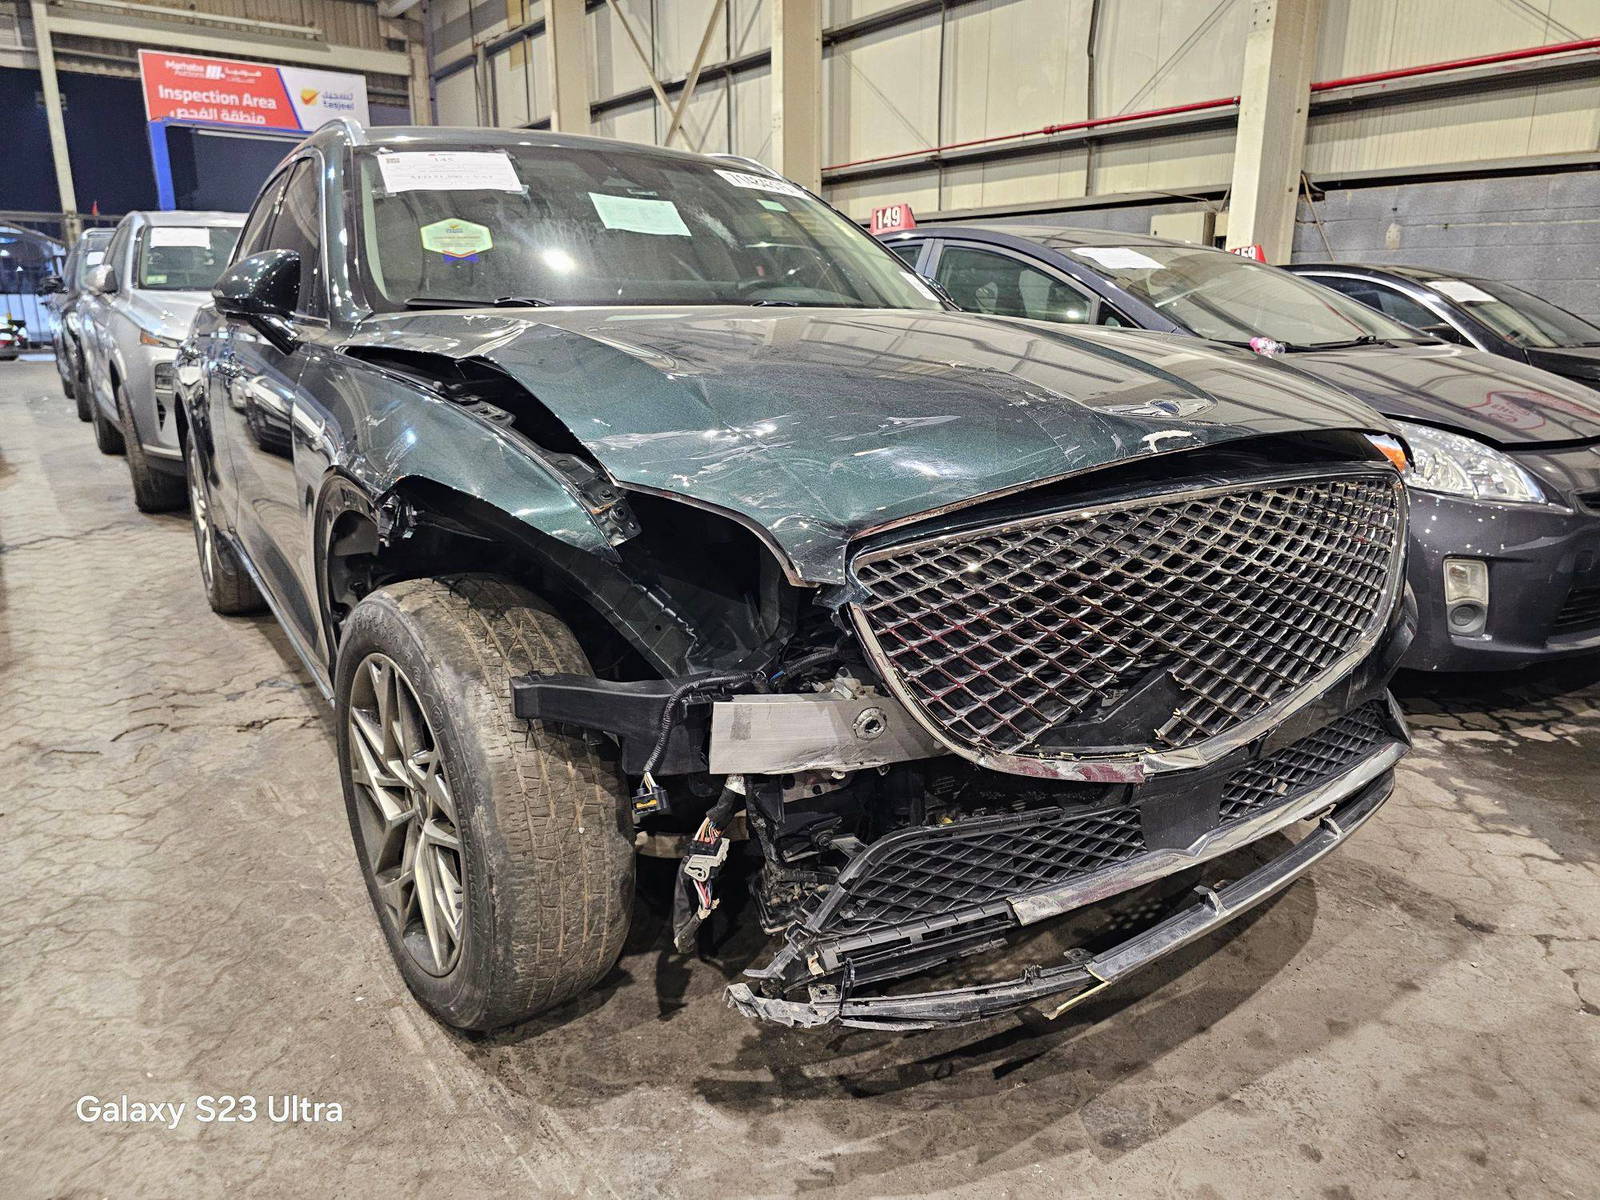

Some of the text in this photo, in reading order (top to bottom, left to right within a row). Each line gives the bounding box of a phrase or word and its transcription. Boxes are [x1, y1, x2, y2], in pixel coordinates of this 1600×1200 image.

[158, 84, 277, 110] Inspection Area
[877, 206, 901, 229] 149
